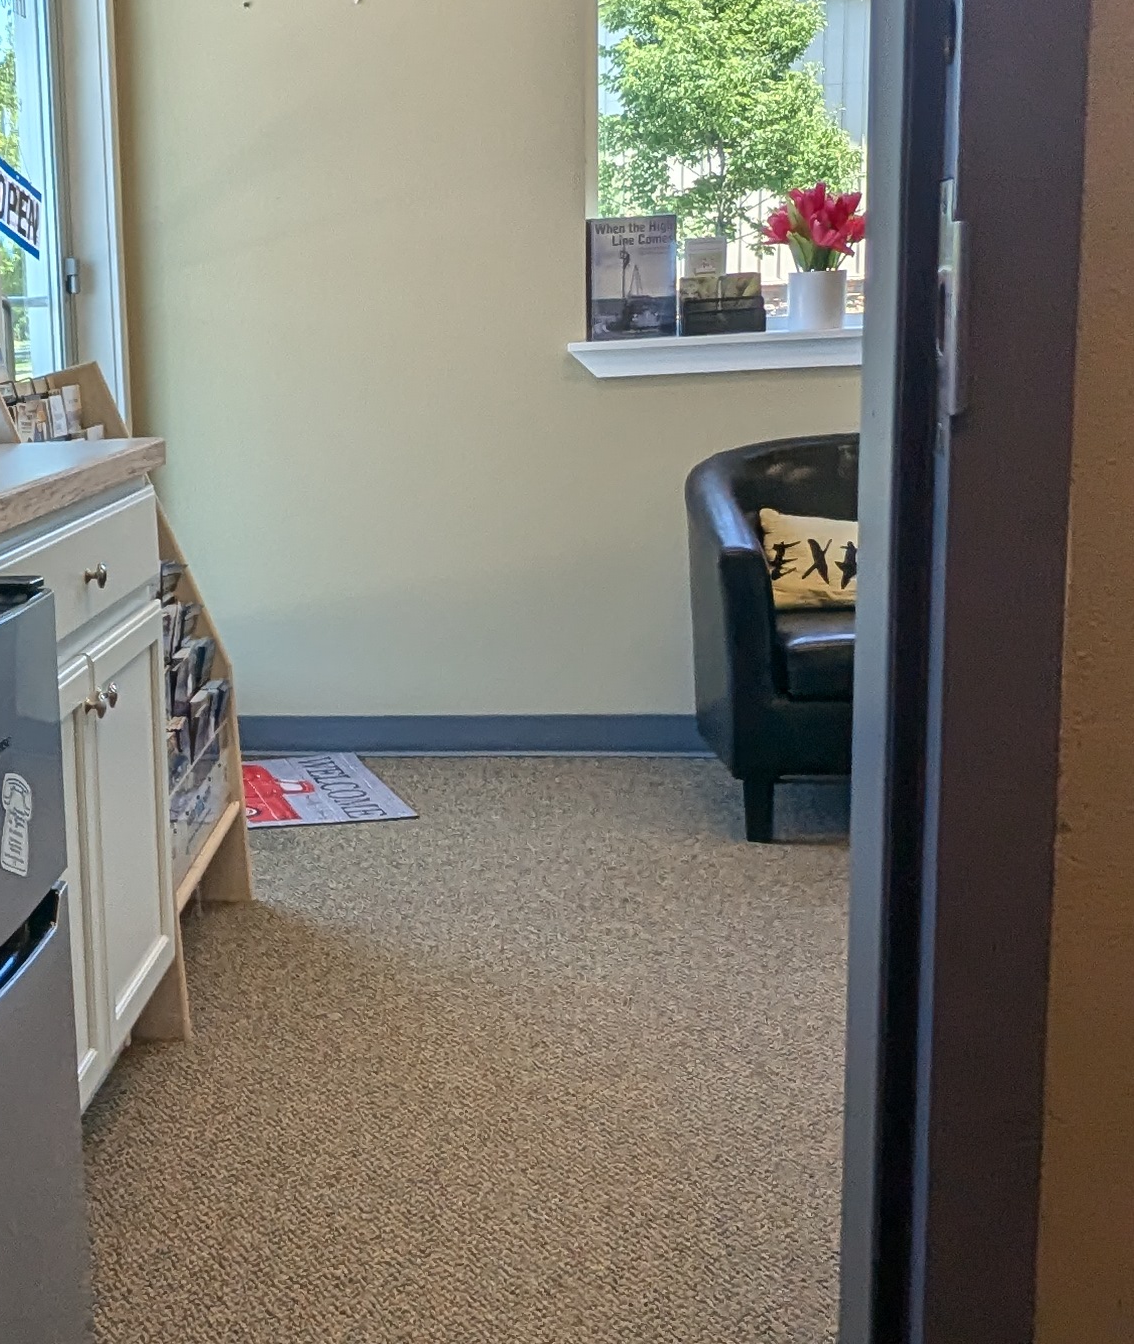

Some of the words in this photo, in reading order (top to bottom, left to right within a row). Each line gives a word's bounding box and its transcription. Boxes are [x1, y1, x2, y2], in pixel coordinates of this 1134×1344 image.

[595, 222, 626, 235] When
[629, 222, 646, 233] the
[612, 234, 635, 247] Line
[638, 233, 674, 245] Comes
[298, 756, 387, 818] WELCOME
